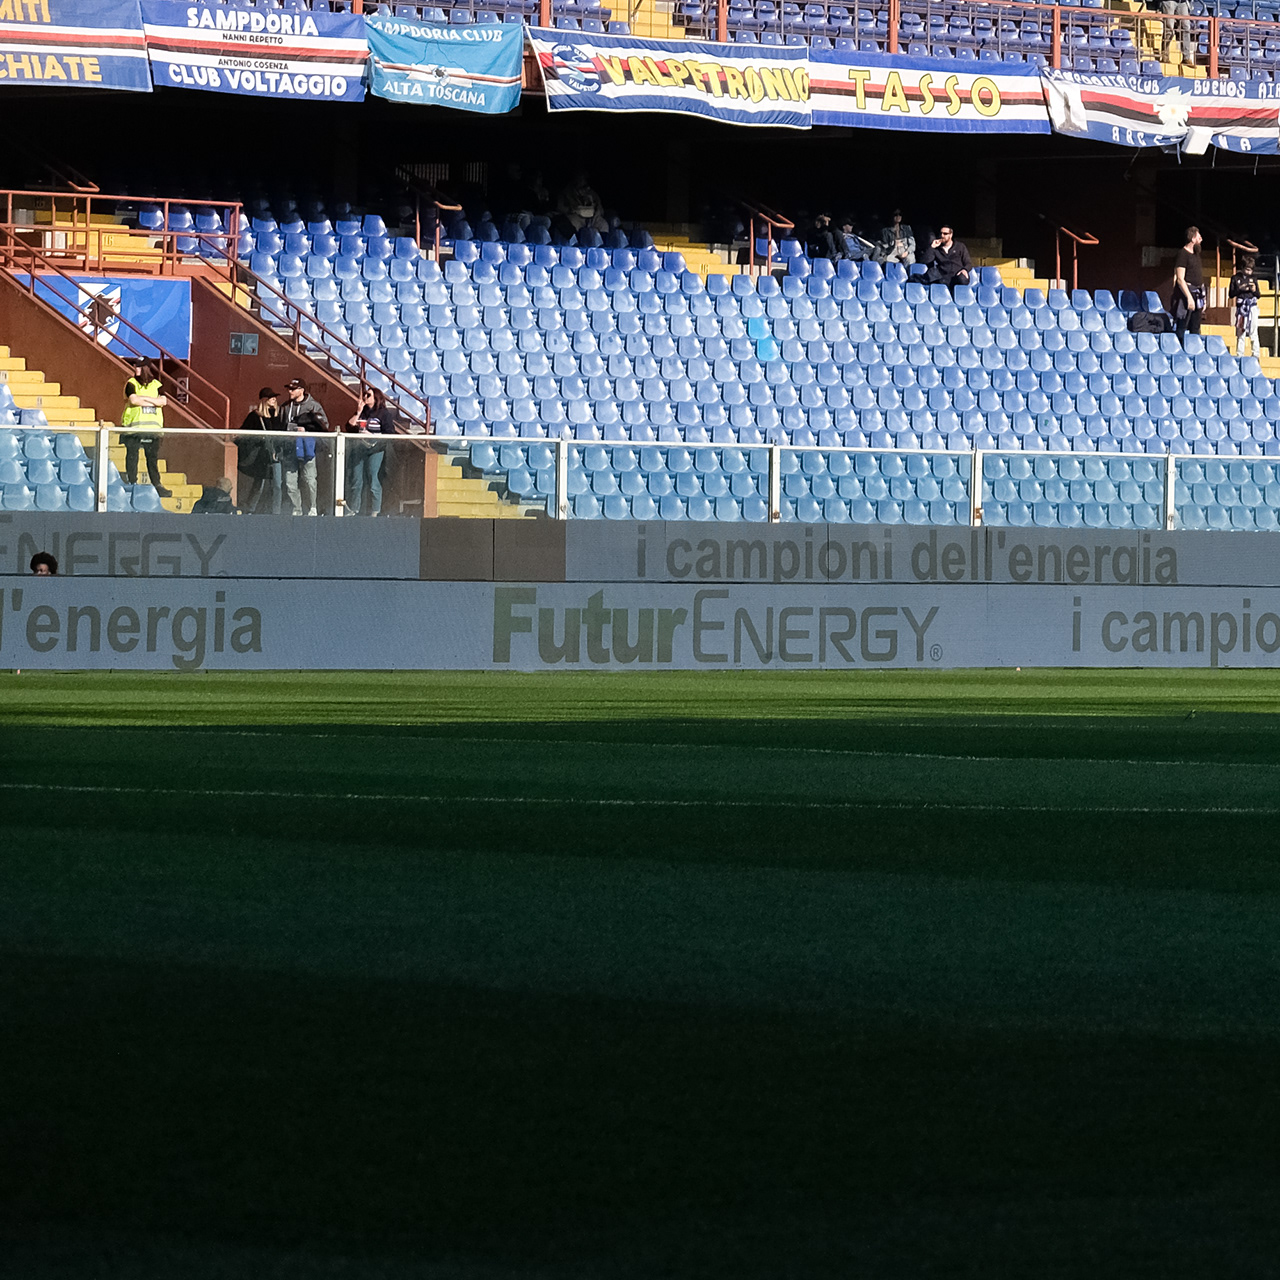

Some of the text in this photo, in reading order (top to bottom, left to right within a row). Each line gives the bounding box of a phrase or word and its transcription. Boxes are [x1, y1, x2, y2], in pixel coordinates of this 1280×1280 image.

[187, 7, 319, 37] SAMPDORIA
[222, 32, 284, 46] NANNI REPETTO
[462, 27, 504, 44] CLUB
[168, 63, 347, 97] CLUB VOLTAGGIO
[218, 57, 290, 71] ANTONIO COSENZA
[596, 51, 811, 104] VALPETRONIO
[382, 79, 486, 107] ALTA TOSCANA
[848, 68, 1002, 117] TASSO
[1128, 75, 1160, 95] CLUB
[0, 515, 227, 576] NERGY
[636, 526, 1179, 586] i campioni dell'energia
[491, 586, 940, 664] FuturENERGY
[1072, 596, 1082, 652] i
